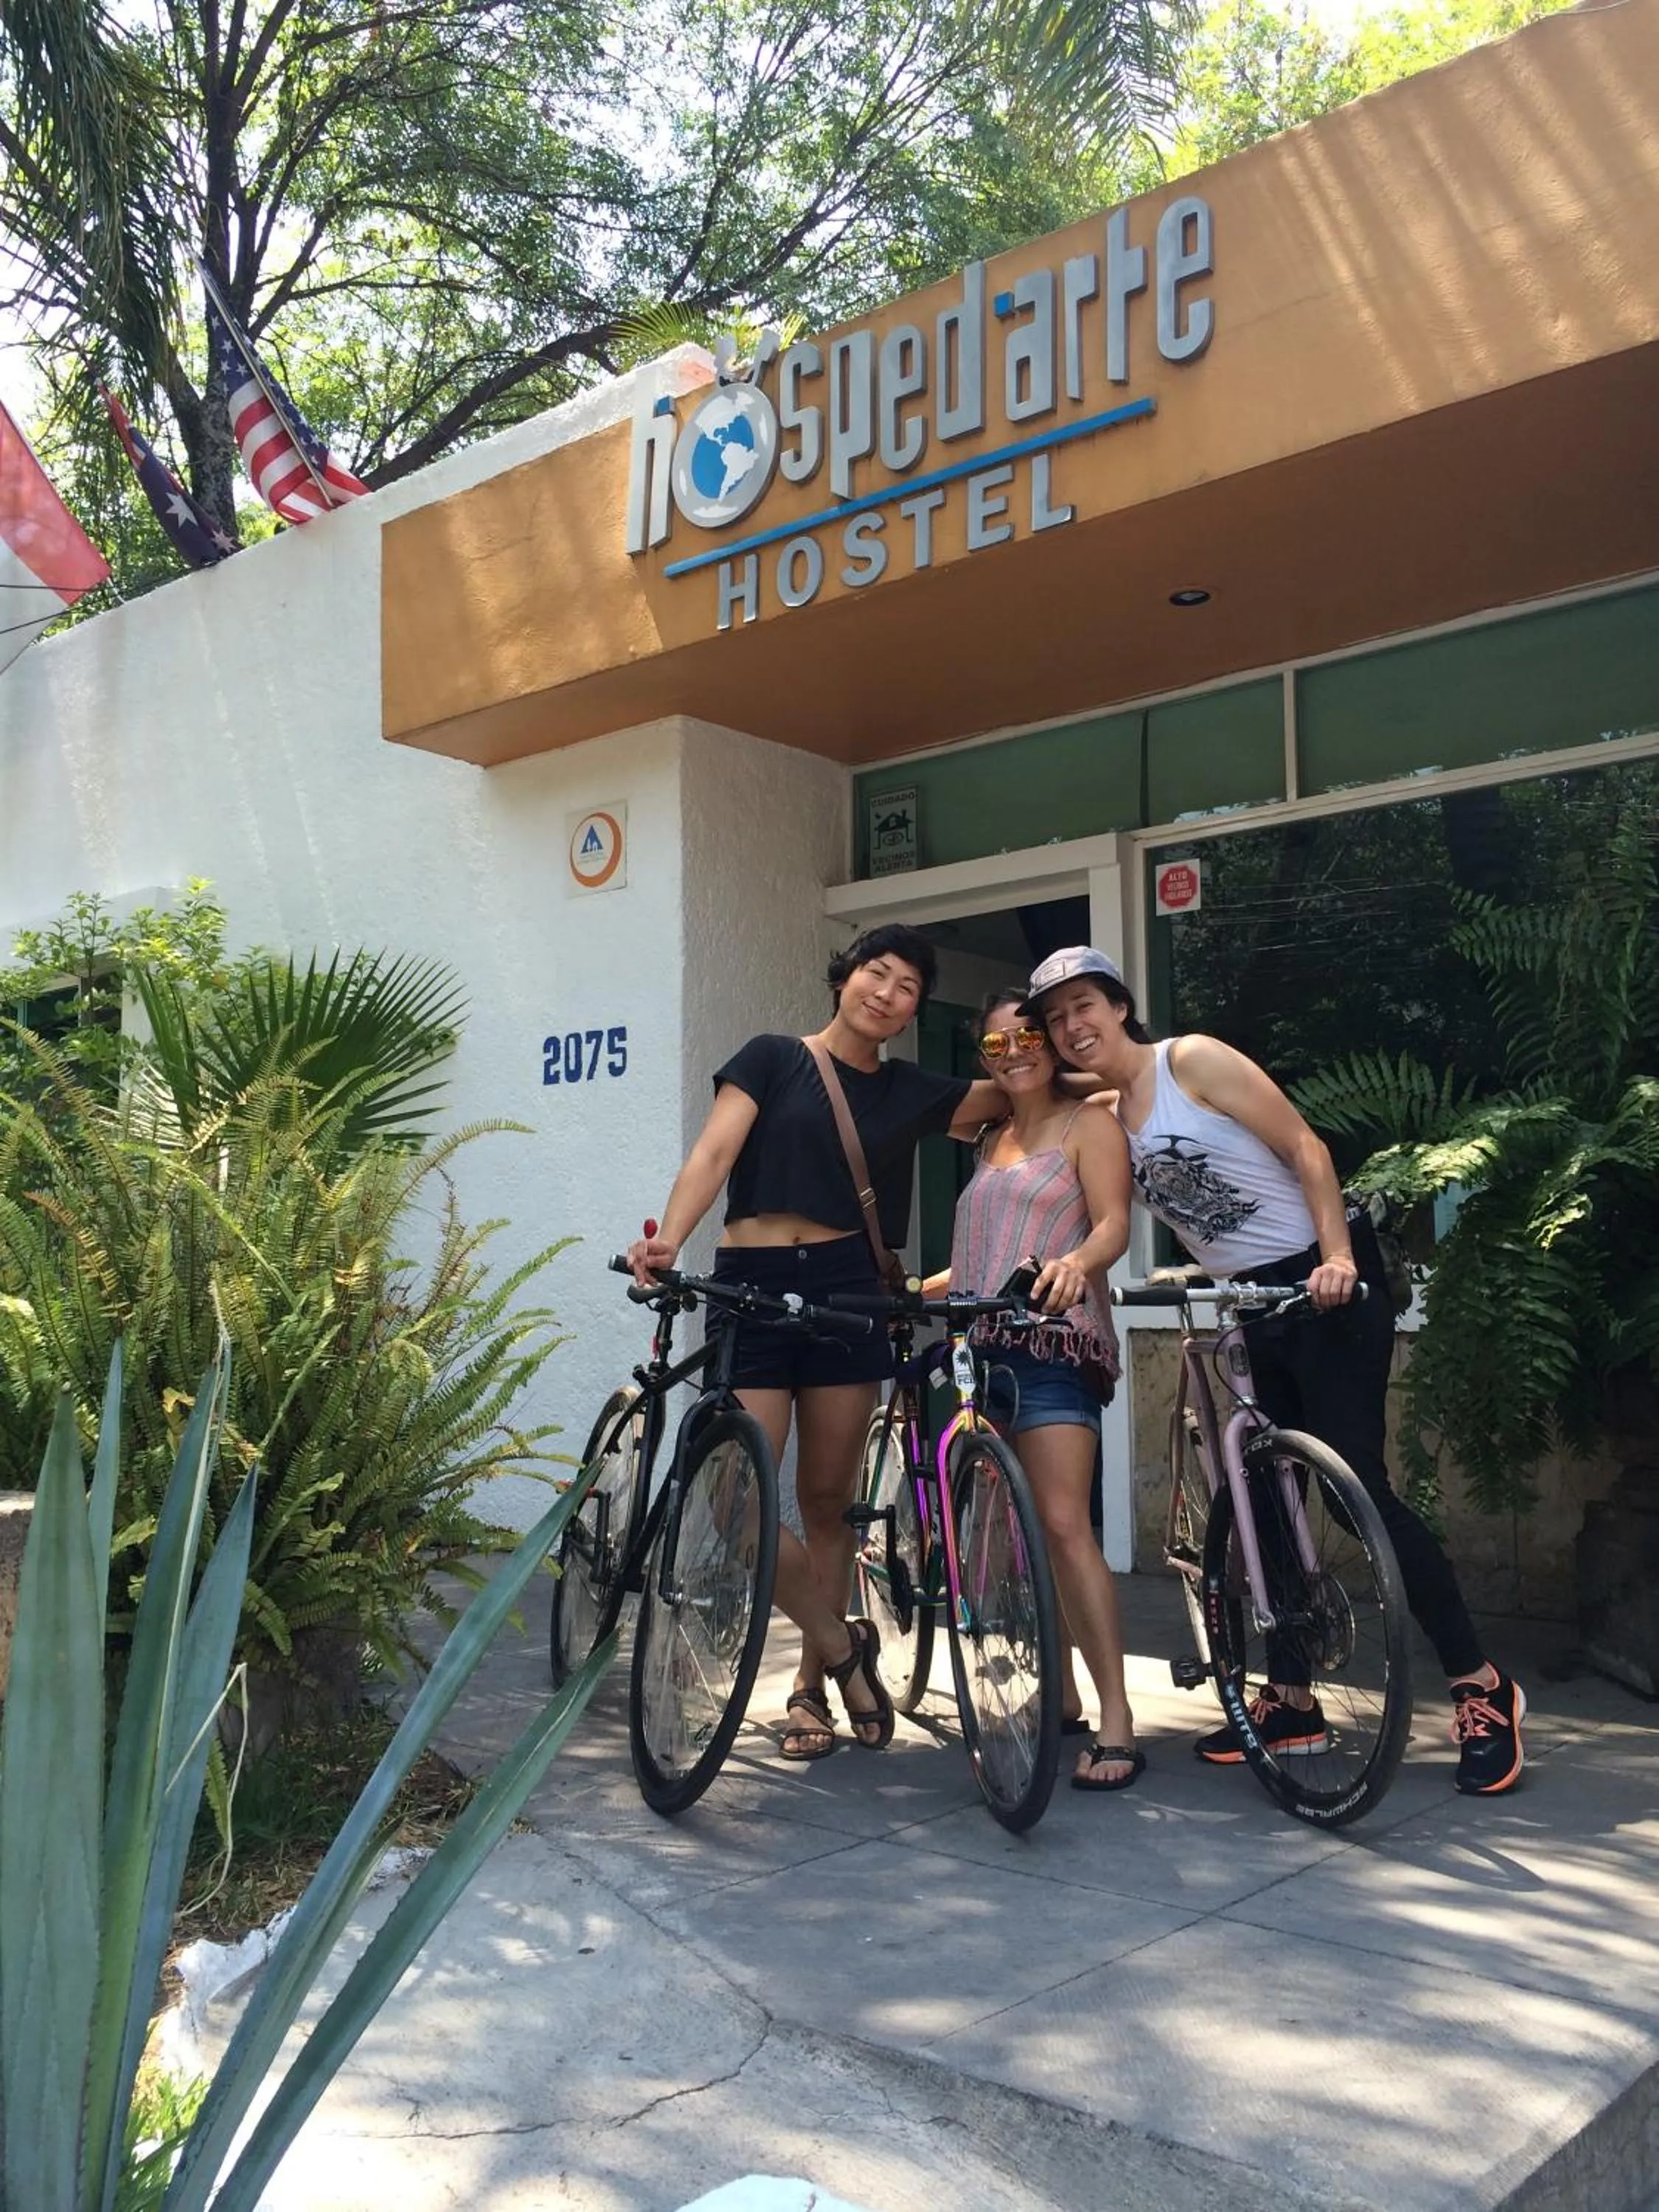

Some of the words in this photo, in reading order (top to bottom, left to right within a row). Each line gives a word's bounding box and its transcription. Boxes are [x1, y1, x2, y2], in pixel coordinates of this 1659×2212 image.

[717, 453, 1077, 631] HOSTEL
[543, 1026, 627, 1085] 2075
[1295, 1781, 1368, 1818] SCHWALBE
